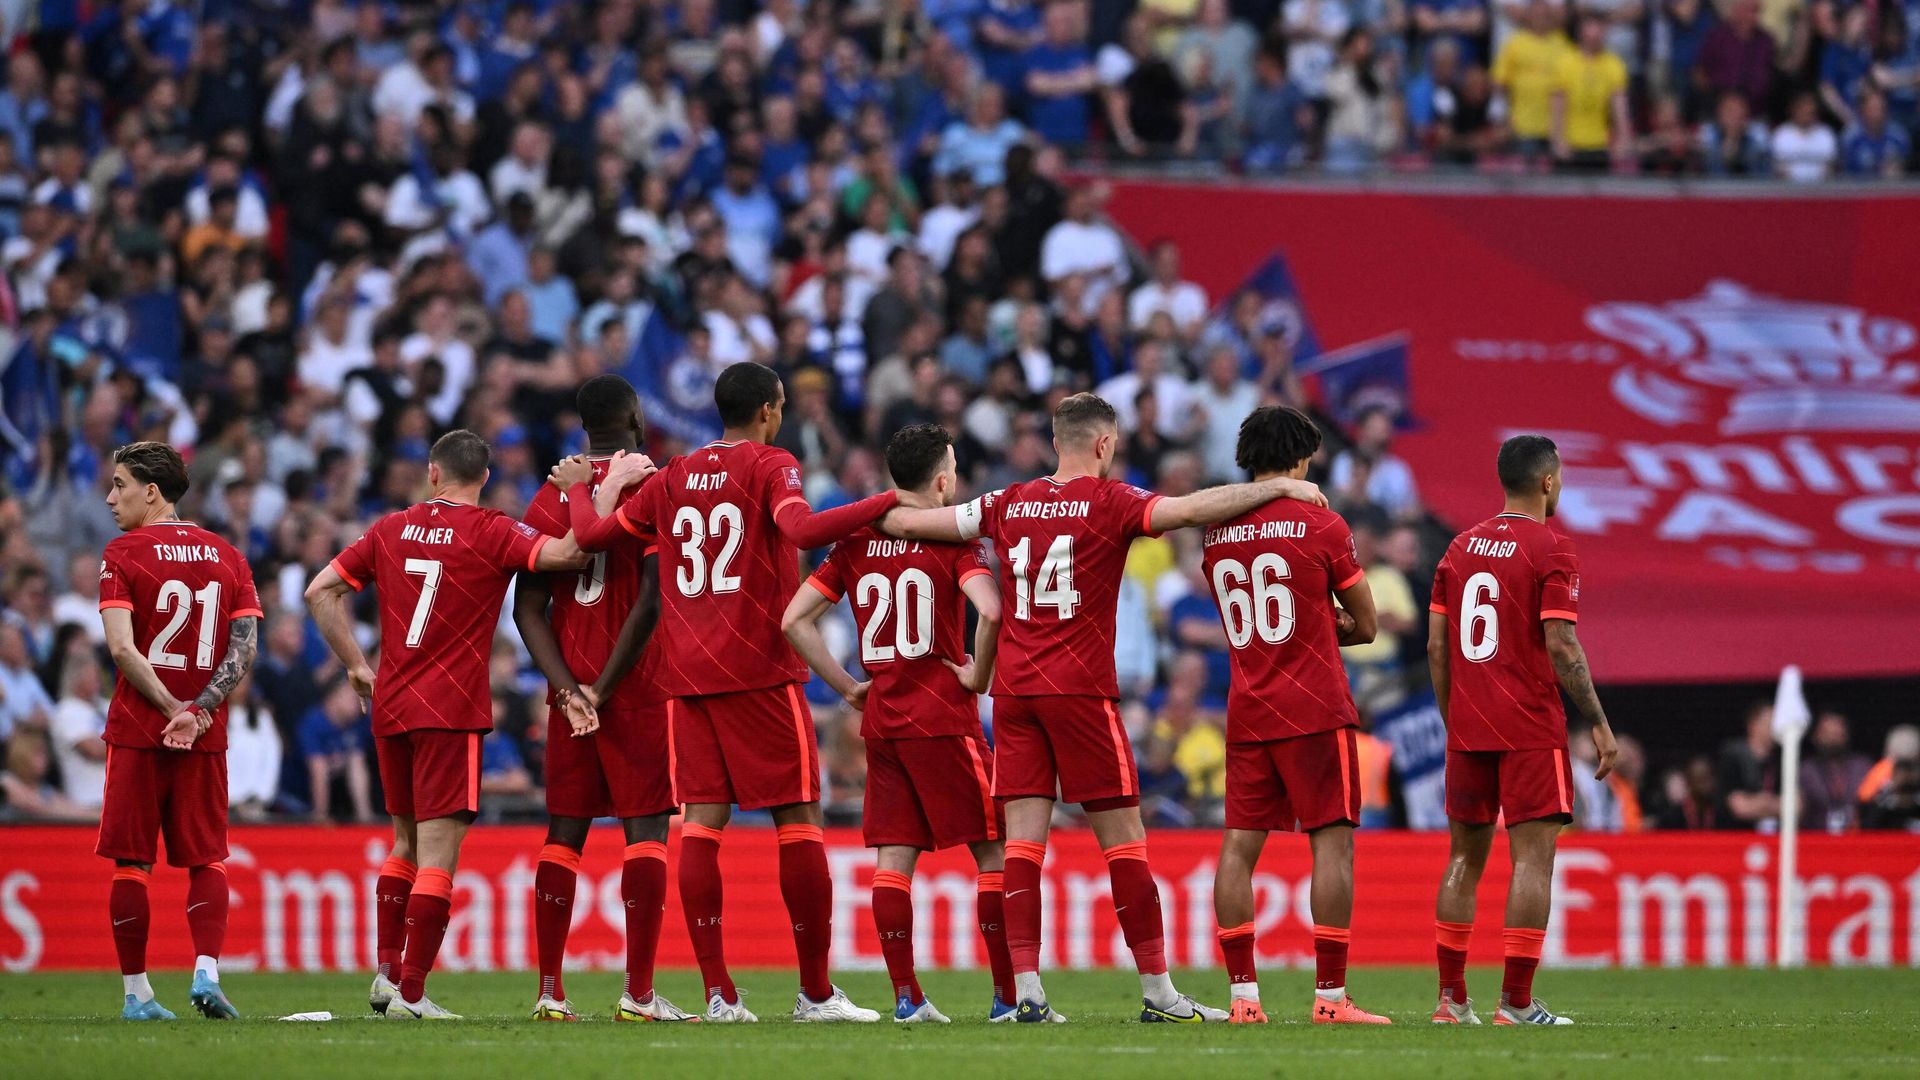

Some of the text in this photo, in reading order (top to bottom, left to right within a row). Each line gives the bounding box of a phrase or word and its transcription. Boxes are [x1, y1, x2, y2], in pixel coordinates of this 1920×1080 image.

[153, 544, 220, 563] TSIMIKAS
[400, 524, 454, 545] MILNER
[672, 502, 745, 598] 32
[1005, 501, 1090, 520] HENDERSON
[1466, 537, 1517, 558] THIAGO
[404, 558, 443, 648] 7
[856, 567, 935, 664] 20
[1008, 534, 1082, 621] 14
[1212, 552, 1296, 650] 66
[1460, 571, 1500, 663] 6
[148, 579, 222, 671] 21
